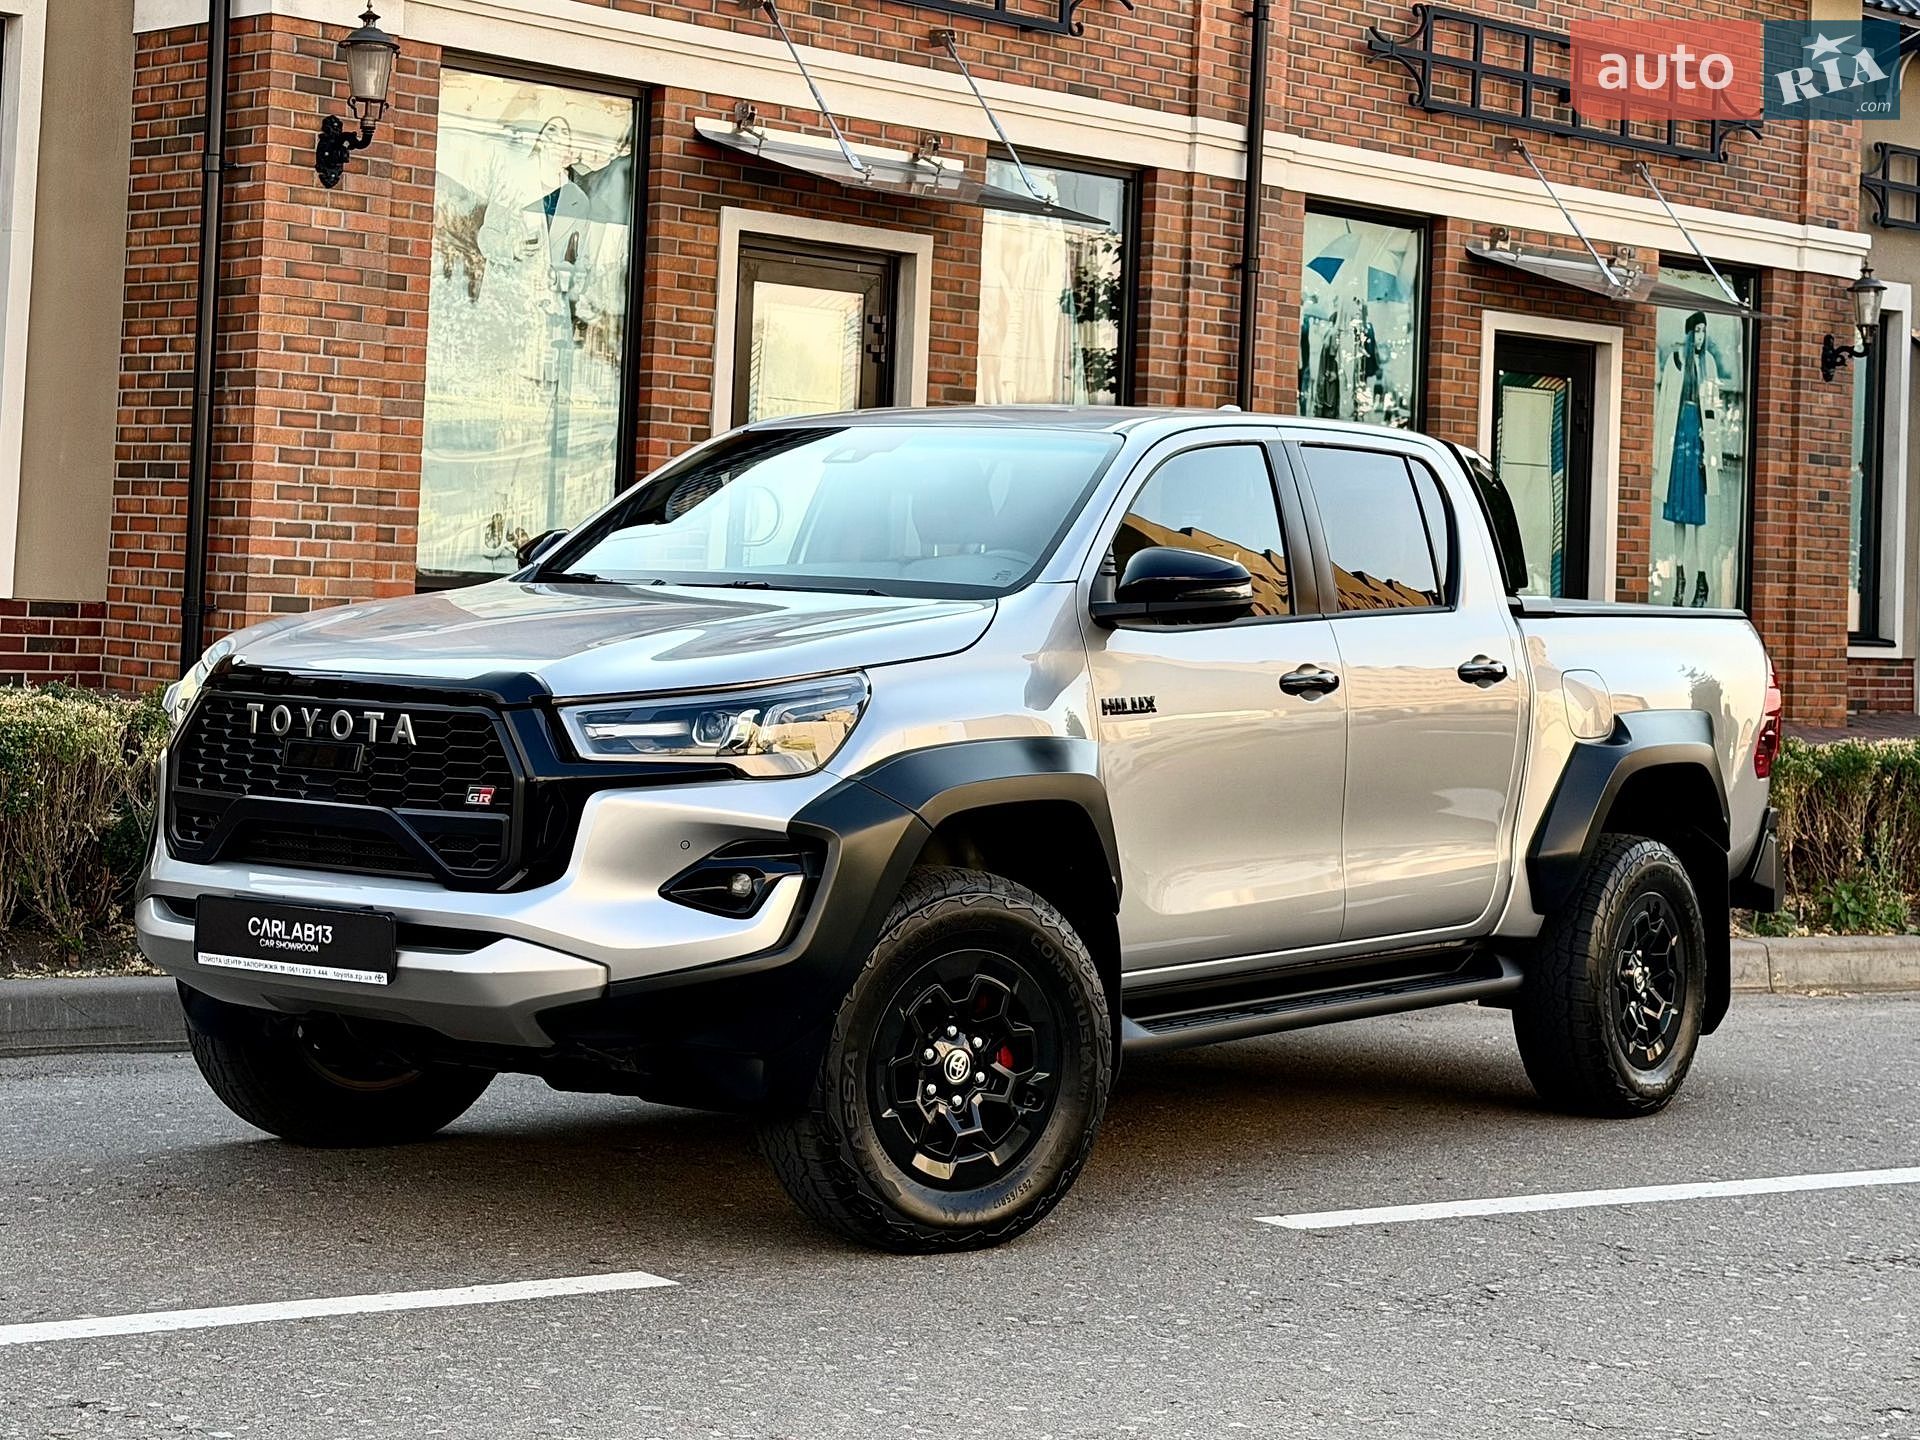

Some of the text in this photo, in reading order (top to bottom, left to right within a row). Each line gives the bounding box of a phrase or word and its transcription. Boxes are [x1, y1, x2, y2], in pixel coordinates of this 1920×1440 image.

[1100, 696, 1157, 716] HILUX
[246, 702, 418, 747] TOYOTA
[467, 793, 492, 803] GR
[247, 916, 333, 944] CARLAB13
[259, 938, 319, 953] CAR SHOWROOM
[223, 957, 242, 967] ЦЕНТР
